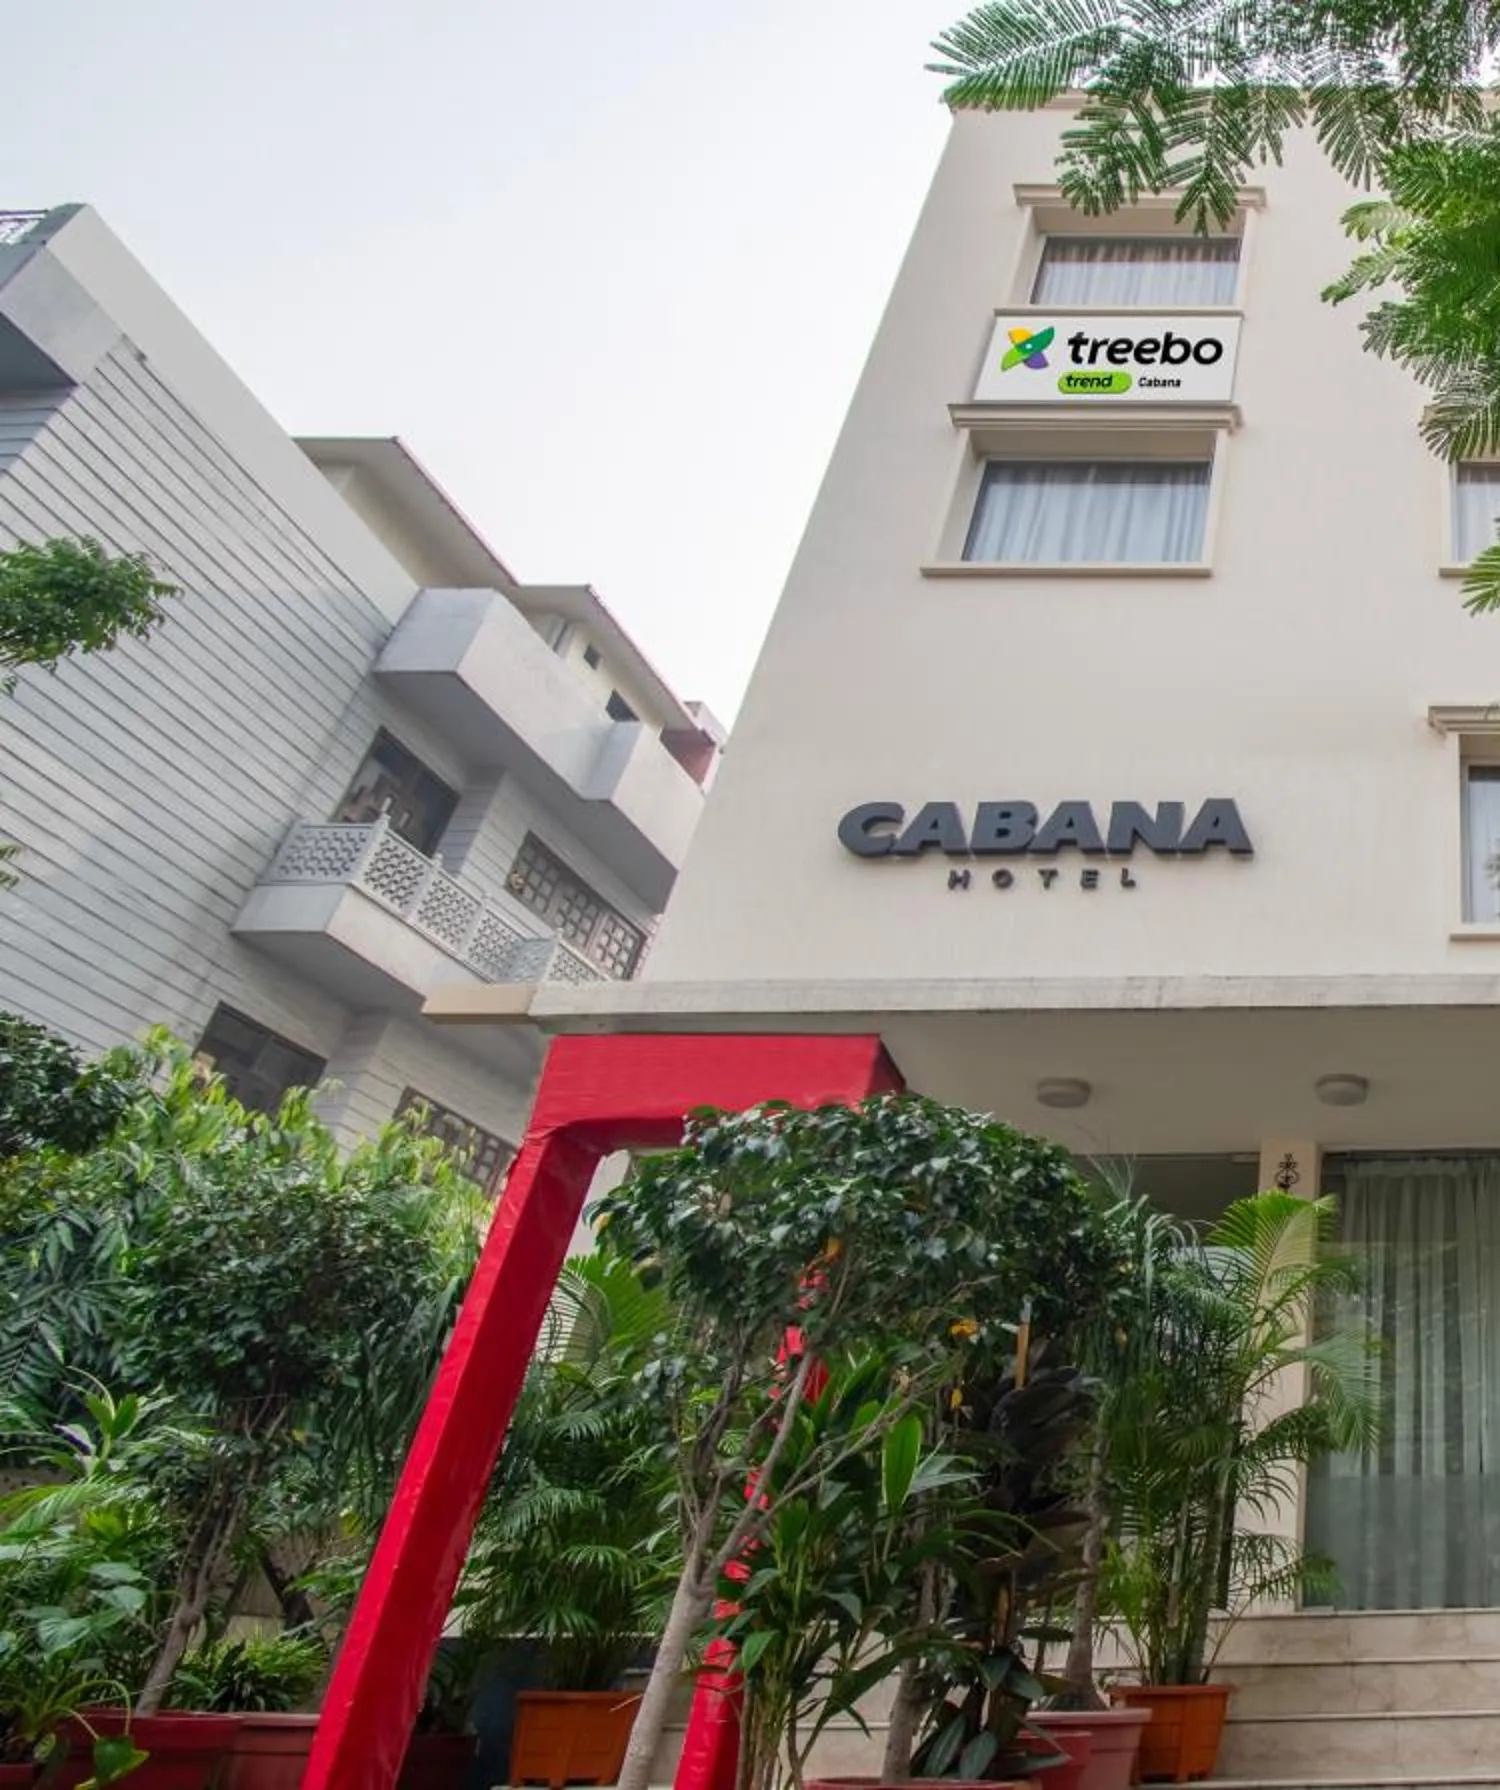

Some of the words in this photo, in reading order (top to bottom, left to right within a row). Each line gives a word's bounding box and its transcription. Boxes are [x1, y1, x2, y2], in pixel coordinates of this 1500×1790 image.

[1067, 331, 1223, 365] treebo
[1065, 374, 1113, 389] trend
[1138, 376, 1182, 388] Cabana
[837, 797, 1255, 858] CABANA
[947, 867, 1136, 890] HOTEL
